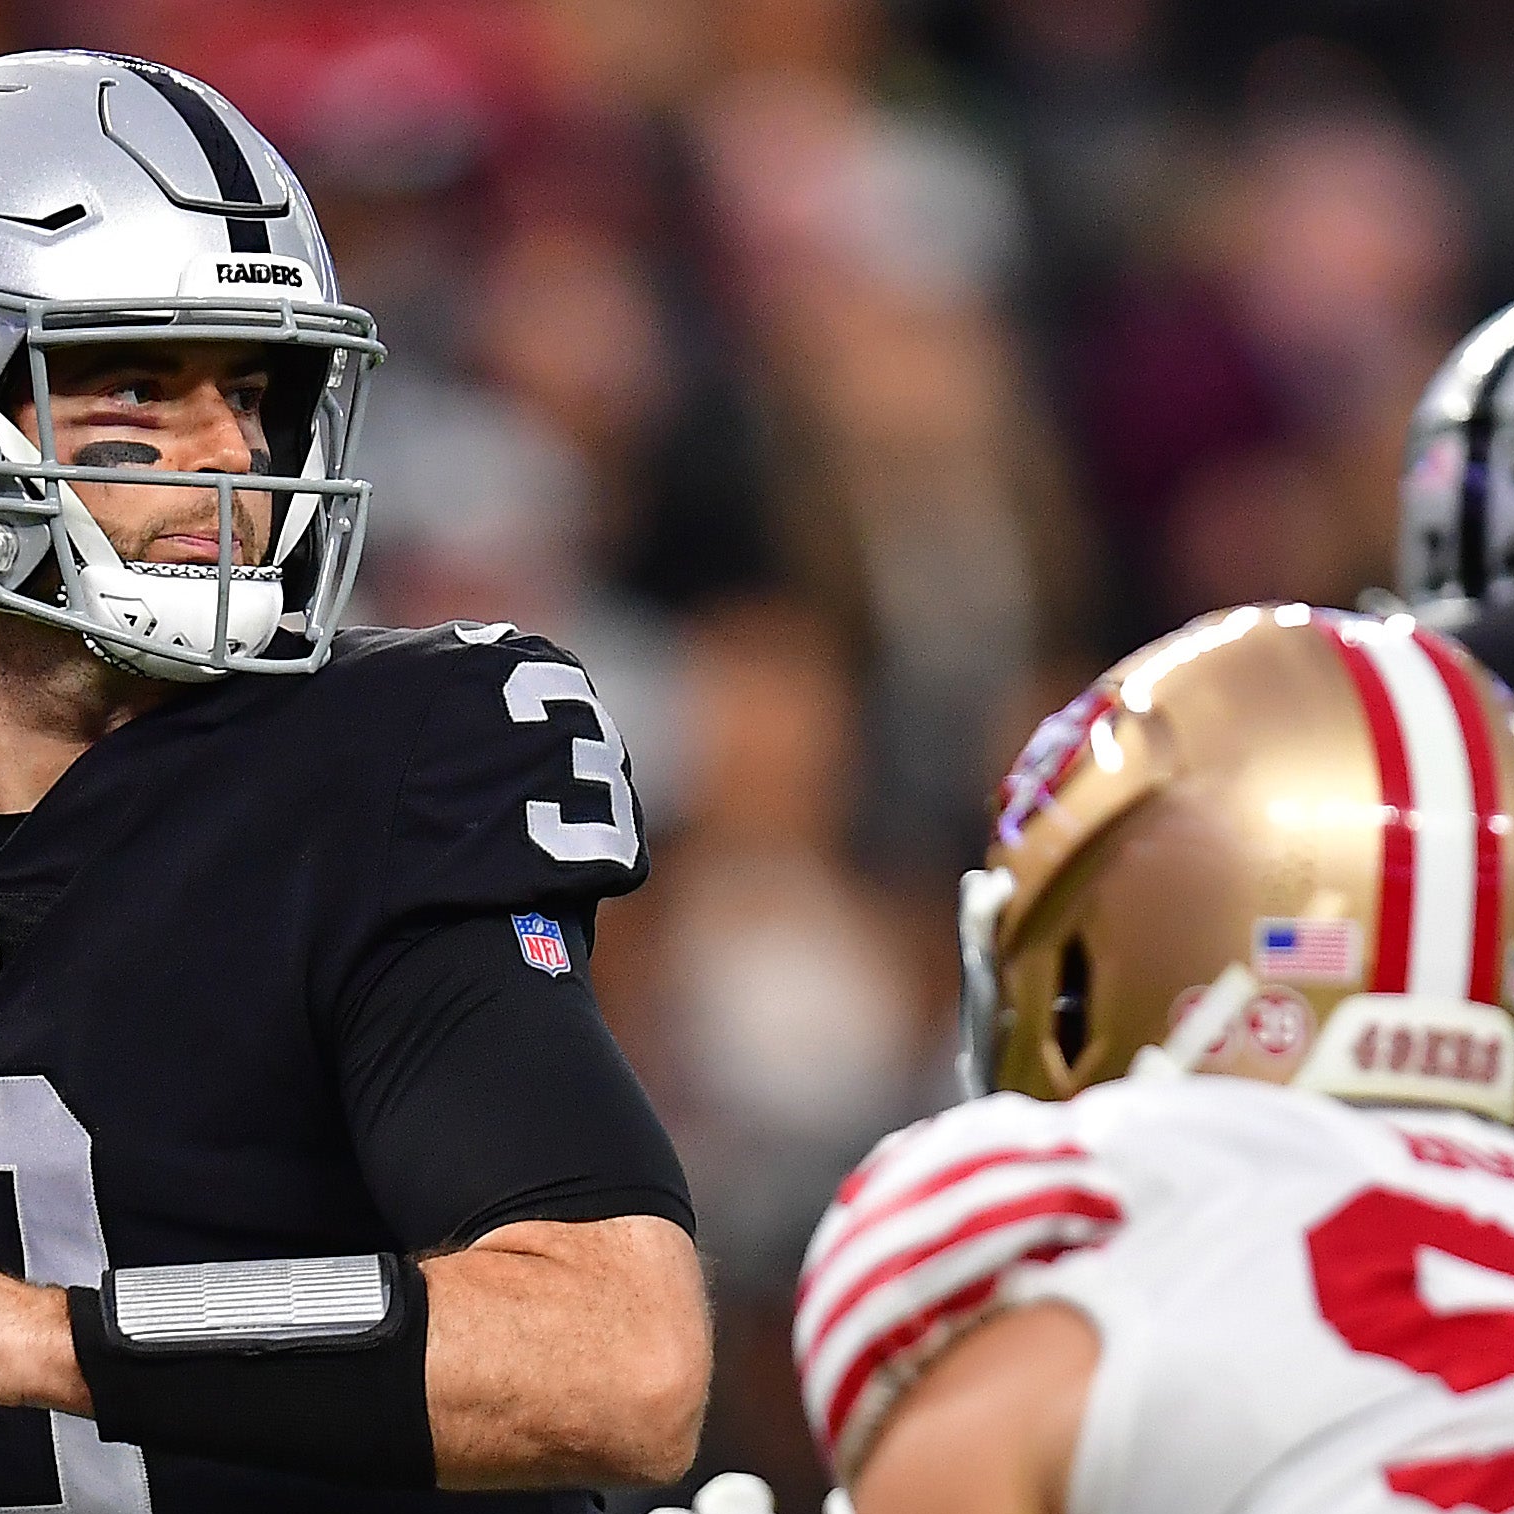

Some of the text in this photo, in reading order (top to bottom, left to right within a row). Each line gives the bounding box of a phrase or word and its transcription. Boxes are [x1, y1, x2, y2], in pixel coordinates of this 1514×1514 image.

[216, 263, 303, 288] RAIDERS
[503, 660, 641, 870] 3
[525, 936, 566, 967] NFL
